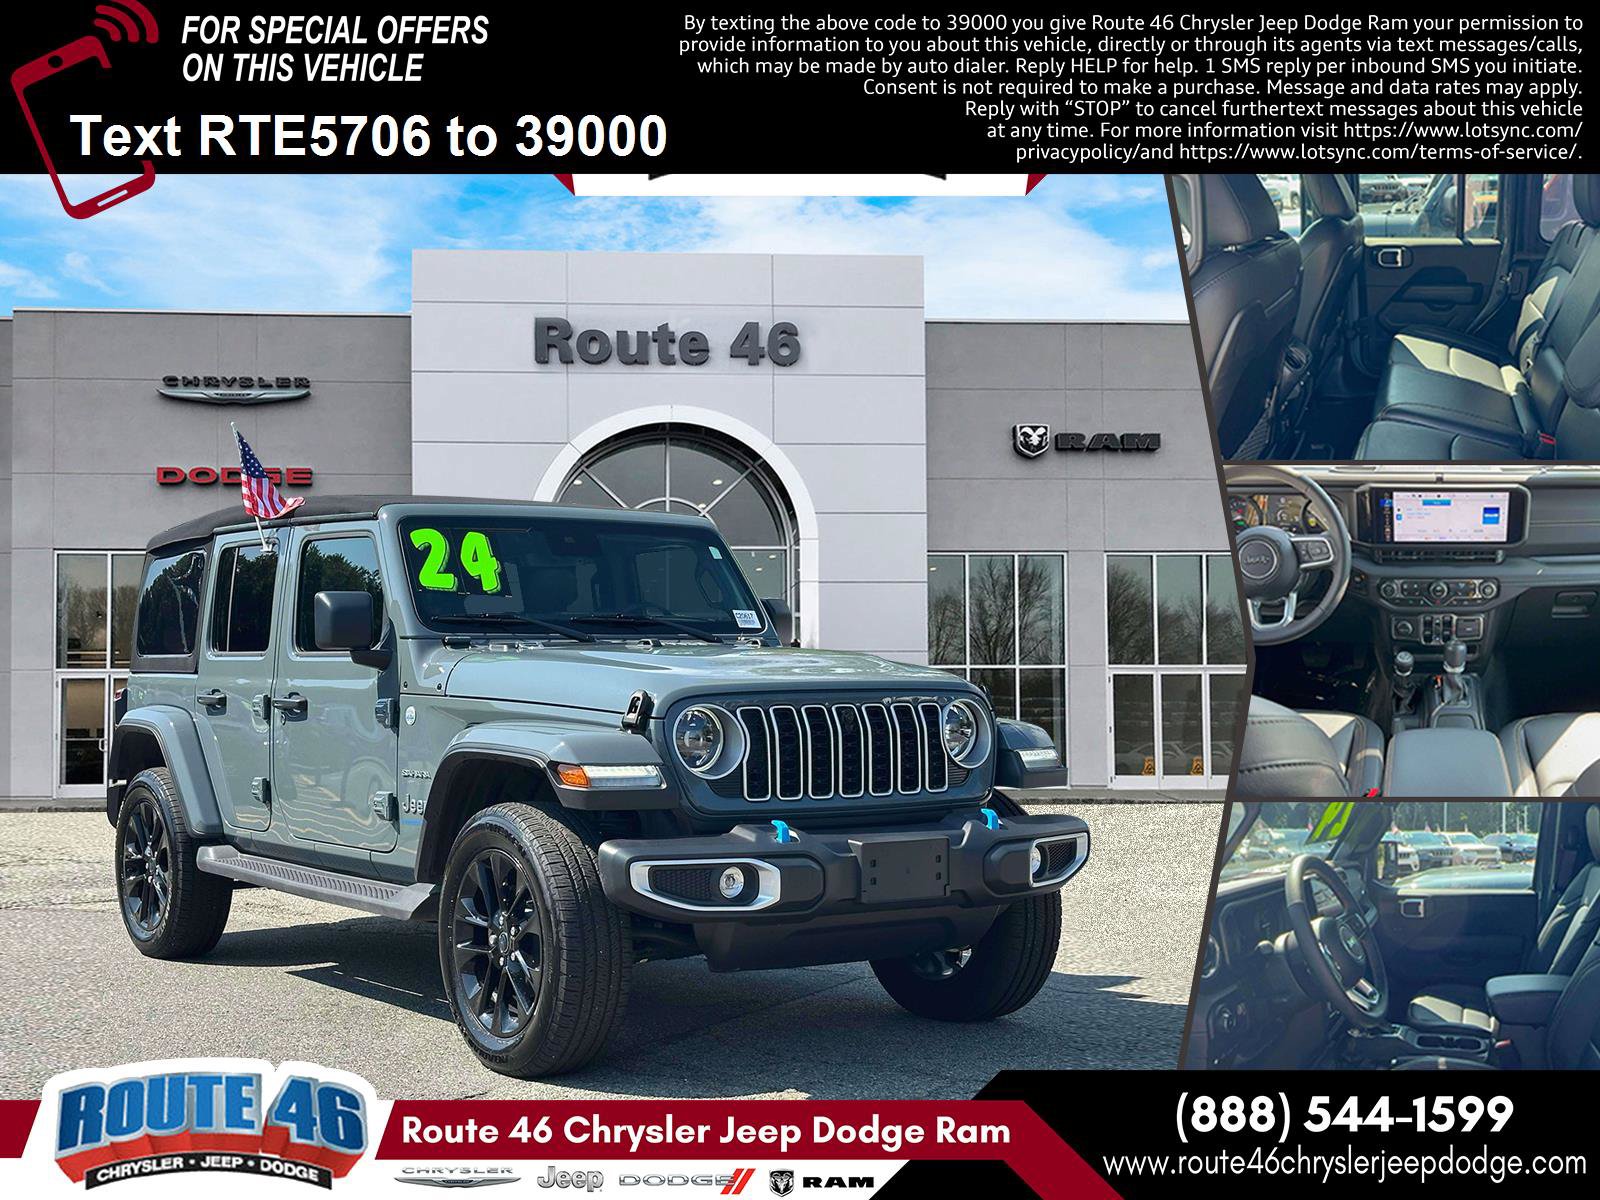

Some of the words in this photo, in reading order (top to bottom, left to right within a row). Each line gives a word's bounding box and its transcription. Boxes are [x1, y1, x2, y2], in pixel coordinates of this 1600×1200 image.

[533, 316, 709, 367] Route
[730, 320, 802, 368] 46
[162, 375, 311, 389] CHRYSLER
[1054, 432, 1161, 453] RAM
[410, 527, 502, 594] 24
